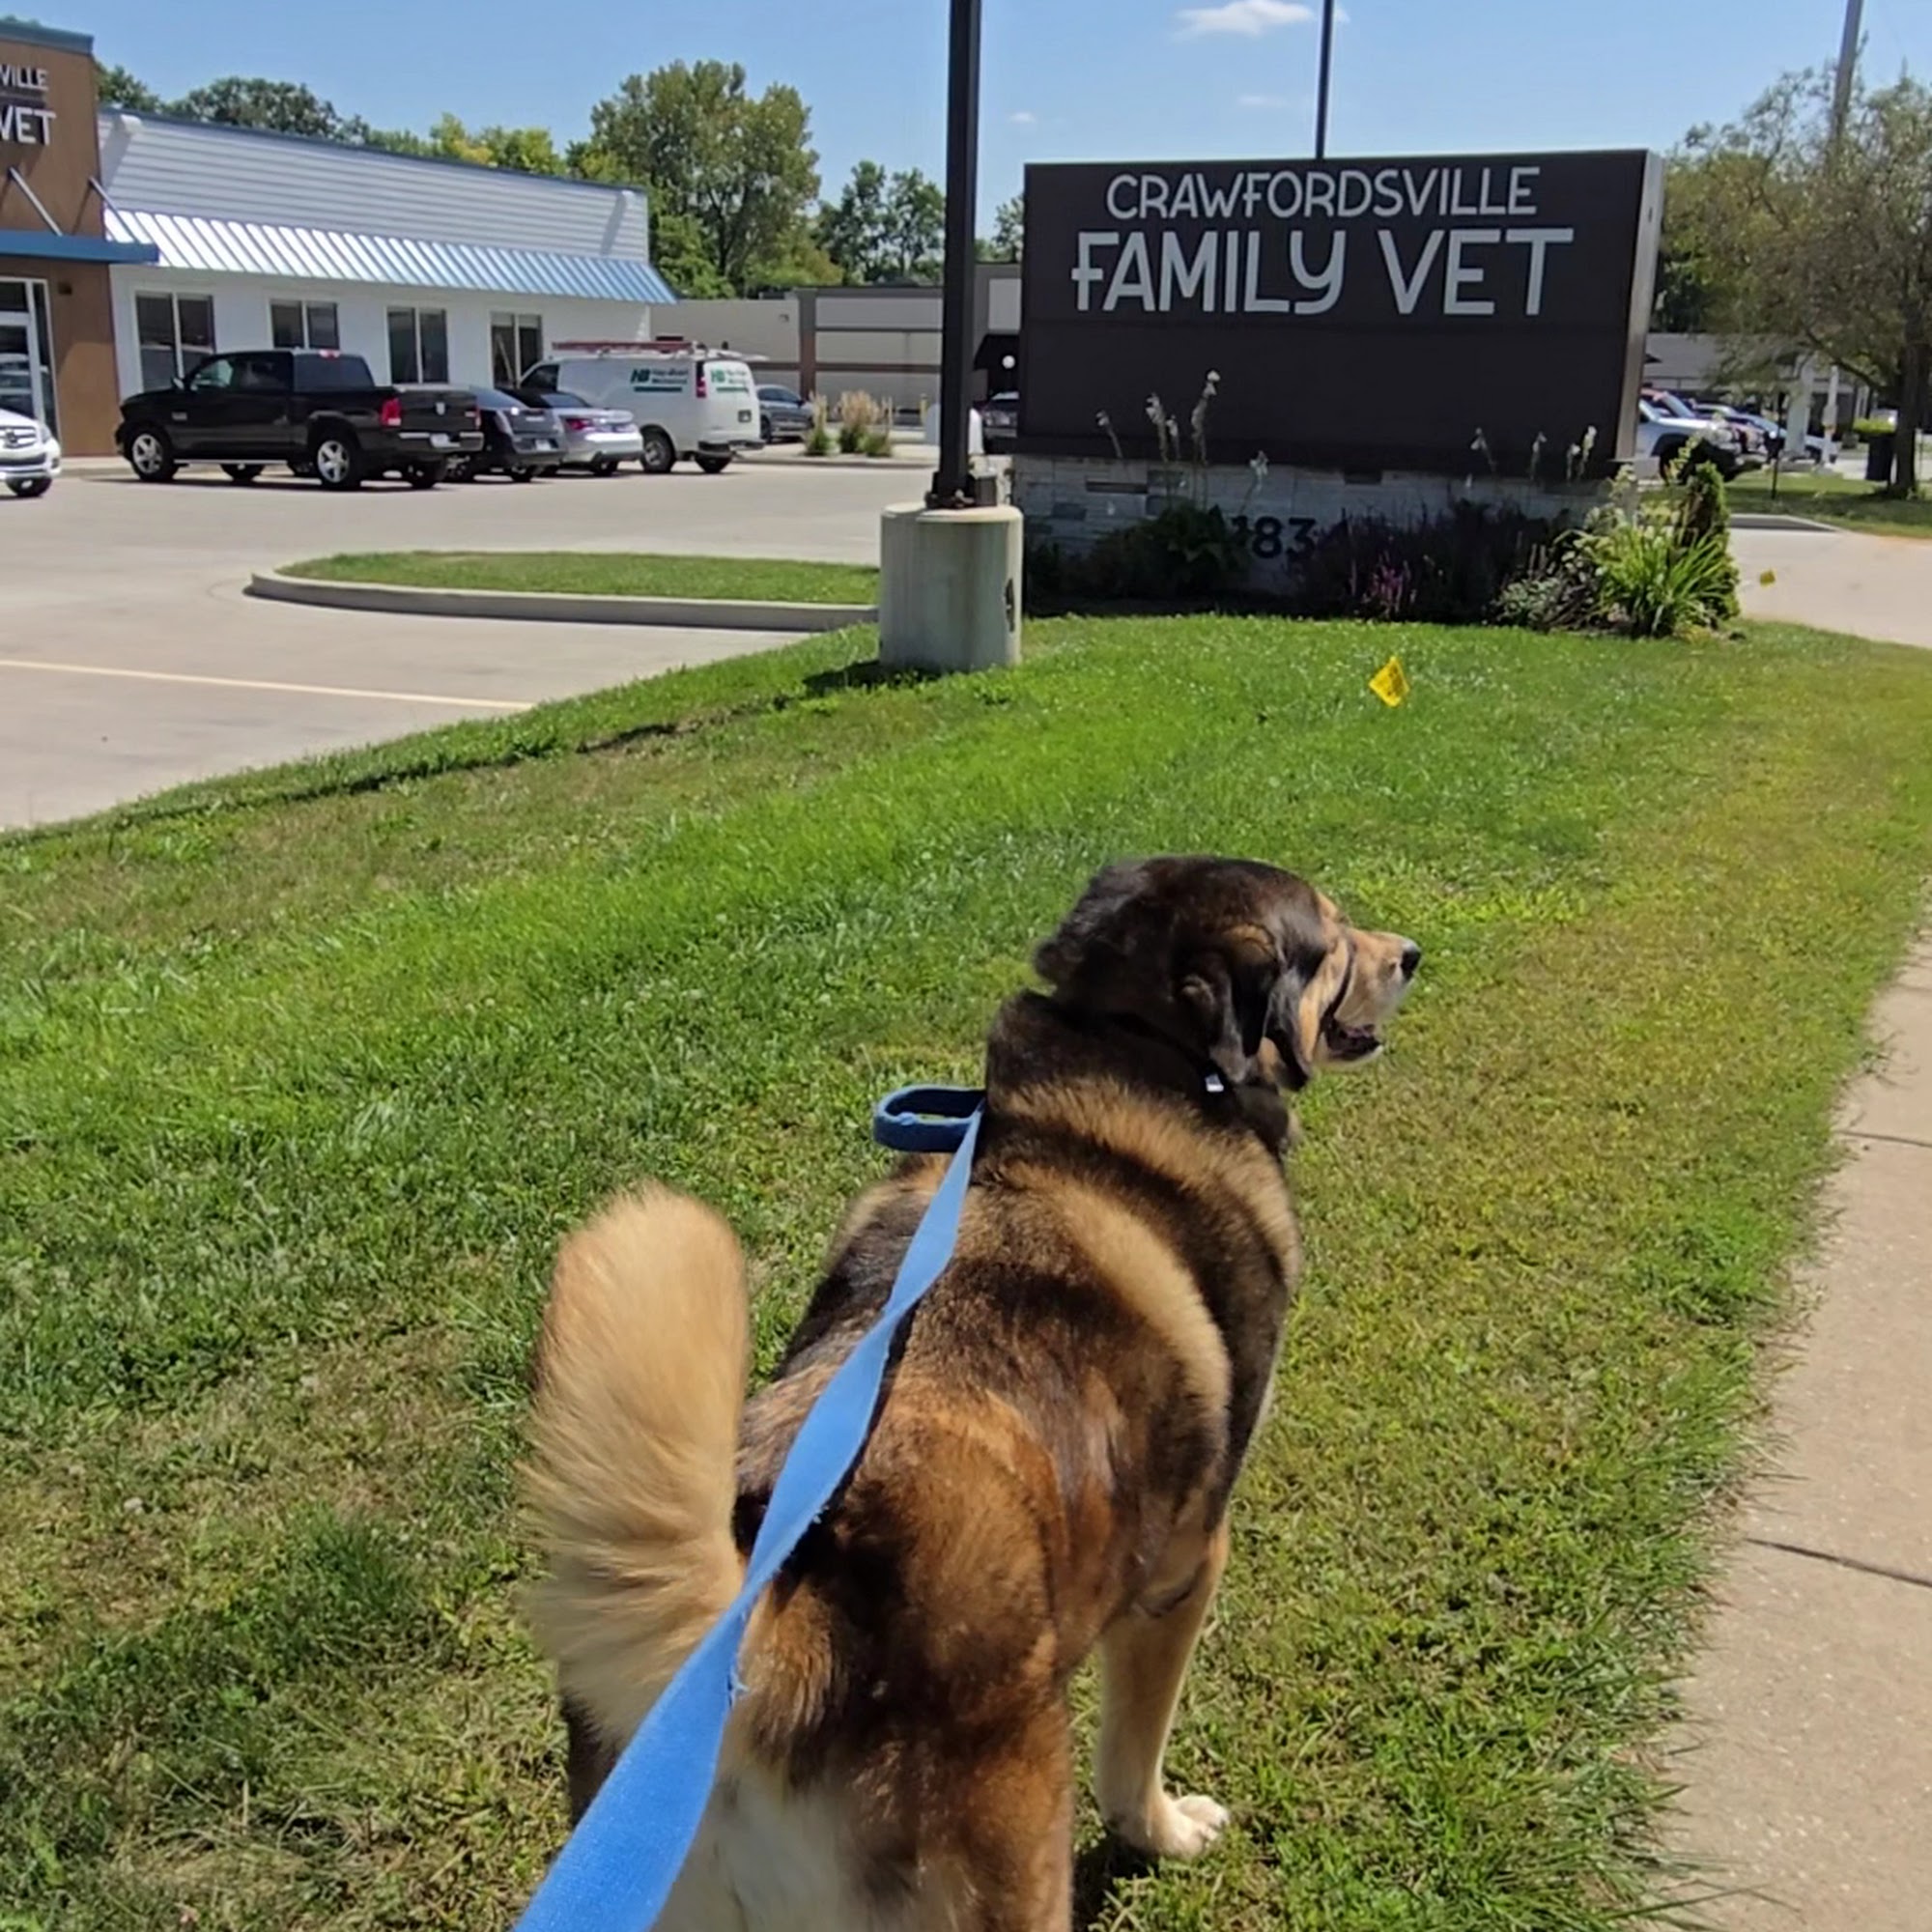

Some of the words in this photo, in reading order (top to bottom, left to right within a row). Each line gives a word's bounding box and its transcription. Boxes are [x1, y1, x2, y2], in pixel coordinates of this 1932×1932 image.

[0, 104, 57, 146] VET
[1107, 166, 1540, 219] CRAWFORDSVILLE
[1071, 230, 1347, 314] FAMILY
[1378, 228, 1574, 315] VET
